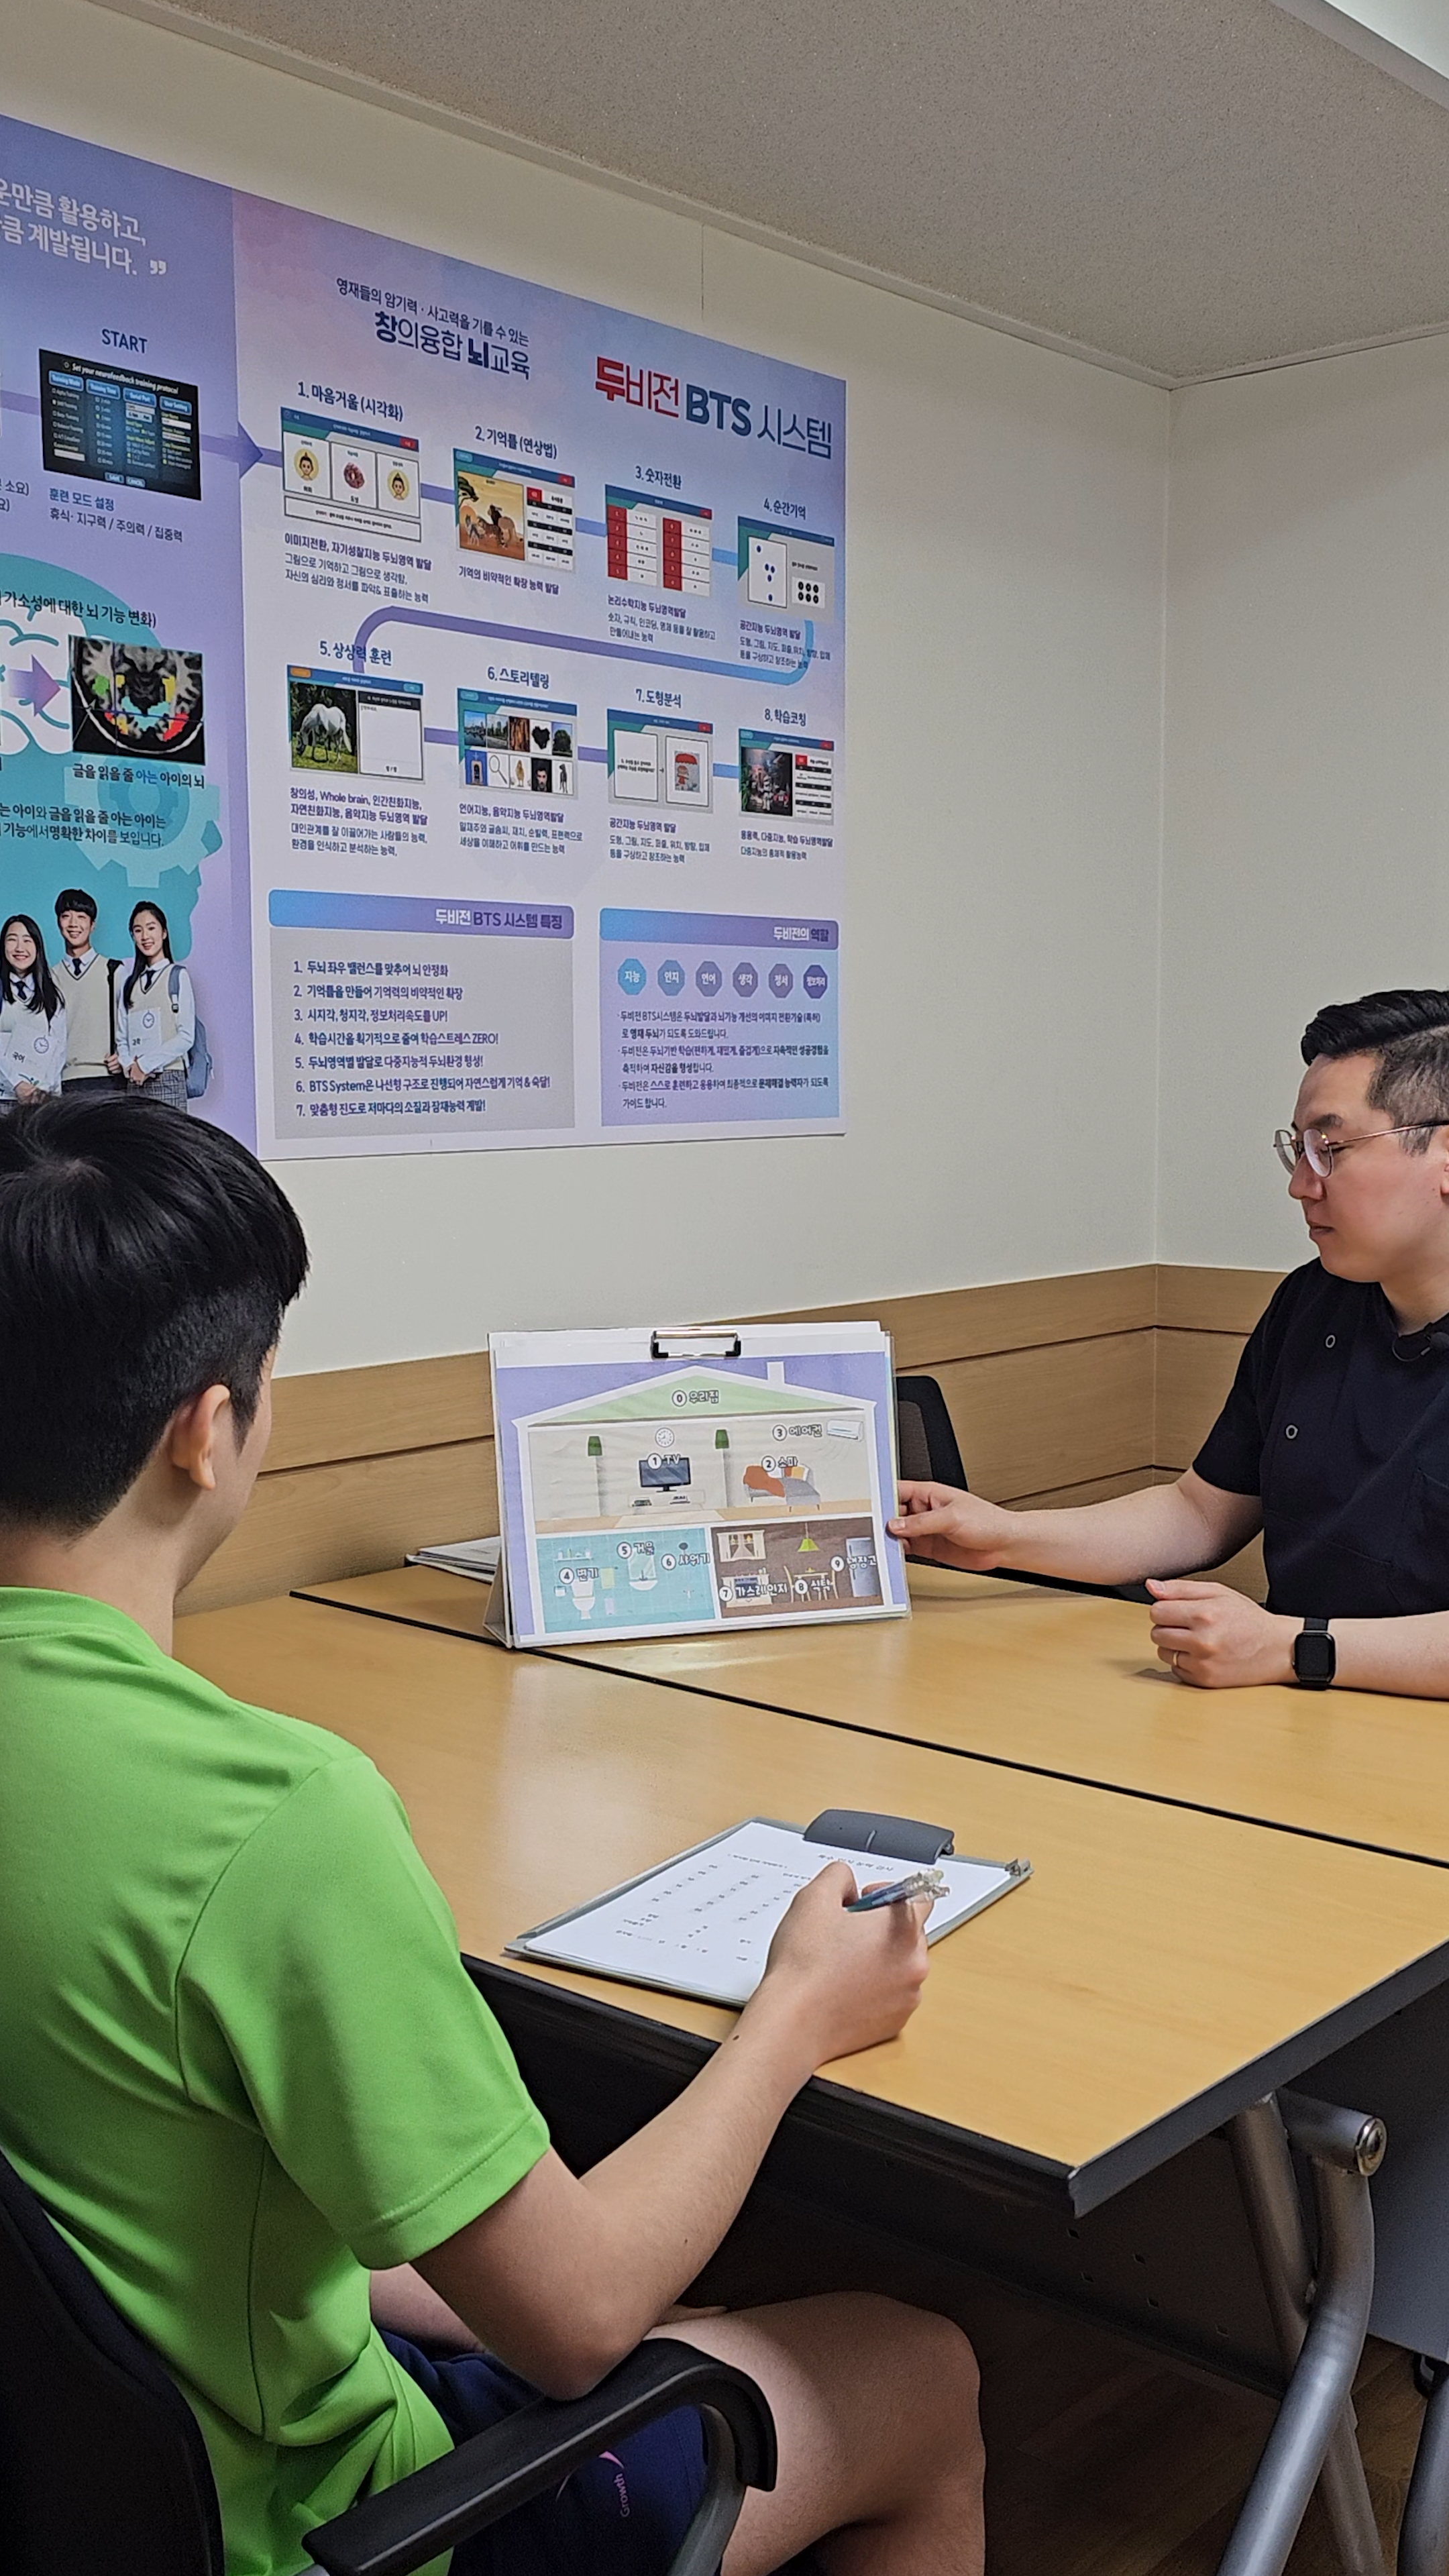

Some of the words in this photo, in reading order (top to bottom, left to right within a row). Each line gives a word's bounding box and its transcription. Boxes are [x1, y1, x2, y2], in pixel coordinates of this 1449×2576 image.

[58, 196, 146, 246] 활용하고,
[0, 215, 24, 245] 큼
[28, 223, 137, 276] 계발됩니다.
[337, 278, 381, 305] 영재들의
[384, 292, 417, 315] 암기력
[427, 306, 470, 330] 사고력을
[472, 318, 493, 335] 기를
[496, 325, 506, 339] 수
[508, 329, 529, 347] 있는
[102, 329, 147, 354] START
[375, 311, 463, 362] 창의융합
[468, 338, 530, 380] 뇌교육
[72, 363, 80, 372] Set
[82, 366, 95, 374] your
[95, 370, 134, 384] neurofeedback
[136, 378, 156, 390] training
[157, 384, 178, 394] protocol
[298, 382, 309, 398] 1.
[311, 384, 358, 411] 마음거울
[361, 396, 403, 422] (시각화)
[595, 356, 679, 418] 두비전
[686, 384, 751, 437] BTS
[757, 405, 831, 460] 시스템
[475, 426, 485, 442] 2.
[520, 436, 557, 460] (연상법)
[635, 466, 644, 480] 3.
[645, 468, 681, 490] 숫자전환
[50, 488, 69, 503] 훈련
[72, 492, 92, 507] 모드
[95, 496, 114, 511] 설정
[774, 500, 806, 520] 순간기억
[77, 513, 106, 529] 지구력
[117, 519, 145, 535] 주의력
[155, 527, 182, 542] 집중력
[284, 533, 329, 552] 이미지전환,
[331, 541, 380, 559] 자기성찰지능
[382, 551, 413, 567] 두뇌영역
[417, 557, 431, 571] 발달
[285, 553, 317, 568] 그림으로
[319, 559, 349, 574] 기억하고
[351, 565, 381, 580] 그림으로
[286, 569, 309, 583] 자신의
[311, 574, 335, 586] 심리와
[337, 578, 358, 591] 정서를
[384, 586, 412, 602] 표출하는
[415, 592, 429, 603] 능력
[459, 566, 480, 580] 기억의
[483, 571, 512, 586] 비약적인
[514, 576, 528, 589] 확장
[530, 580, 543, 592] 능력
[545, 582, 559, 595] 발달
[5, 591, 56, 613] 가소성에
[58, 599, 83, 616] 대한
[87, 604, 98, 619] 뇌
[101, 606, 126, 624] 기능
[129, 610, 156, 629] 변화)
[319, 641, 331, 657] 5.
[333, 643, 366, 663] 상상력
[370, 648, 392, 666] 훈련
[488, 667, 497, 681] 6.
[499, 668, 549, 689] 스토리텔링
[636, 688, 645, 702] 7.
[646, 690, 682, 708] 도형분석
[765, 708, 773, 722] 8.
[775, 709, 806, 727] 학습코칭
[72, 763, 96, 780] 글을
[99, 765, 121, 782] 읽을
[123, 768, 133, 783] 줄
[136, 769, 158, 785] 아는
[160, 772, 192, 788] 아이의
[194, 775, 205, 789] 뇌
[290, 787, 317, 801] 창의성,
[320, 791, 346, 803] Whole
[13, 804, 47, 820] 아이와
[49, 806, 72, 822] 글을
[74, 808, 95, 824] 읽을
[98, 810, 109, 824] 줄
[111, 812, 133, 827] 아는
[135, 813, 166, 829] 아이는
[345, 808, 376, 822] 음악지능
[379, 812, 410, 824] 두뇌영역
[413, 814, 427, 826] 발달
[85, 828, 117, 844] 차이를
[120, 831, 164, 847] 보입니다.
[436, 908, 471, 925] 두비전
[474, 912, 501, 926] BTS
[504, 913, 538, 928] 시스템
[541, 914, 562, 930] 특징
[773, 927, 809, 941] 두비전의
[294, 961, 303, 973] 1.
[307, 961, 325, 973] 두뇌
[328, 961, 345, 973] 좌우
[347, 962, 382, 976] 밸런스를
[385, 963, 411, 977] 맞추어
[413, 964, 421, 976] 뇌
[423, 964, 448, 977] 안정화
[625, 970, 640, 983] 지능
[664, 971, 680, 984] 인지
[702, 972, 716, 985] 언어
[738, 973, 753, 986] 생각
[774, 975, 788, 987] 정서
[294, 1009, 303, 1022] 3.
[308, 1008, 338, 1022] 시지각,
[339, 1009, 369, 1023] 청지각,
[370, 1009, 431, 1022] 정보처리속도를
[433, 1010, 447, 1022] UP!
[294, 1032, 304, 1046] 4.
[309, 1032, 354, 1046] 학습시간을
[356, 1032, 400, 1046] 획기적으로
[402, 1033, 419, 1045] 줄여
[421, 1032, 471, 1045] 학습스트레스
[472, 1032, 498, 1044] ZERO!
[623, 1097, 643, 1109] 가이드
[645, 1097, 667, 1109] 합니다.
[689, 1389, 719, 1404] 우리집
[789, 1424, 822, 1438] 에어컨
[663, 1454, 681, 1464] TV
[634, 1541, 655, 1556] 거울
[847, 1555, 876, 1569] 냉장고
[576, 1567, 598, 1582] 변기
[810, 1578, 831, 1591] 식탁
[736, 1583, 788, 1598] 가스레인지
[613, 2473, 630, 2517] Growth
